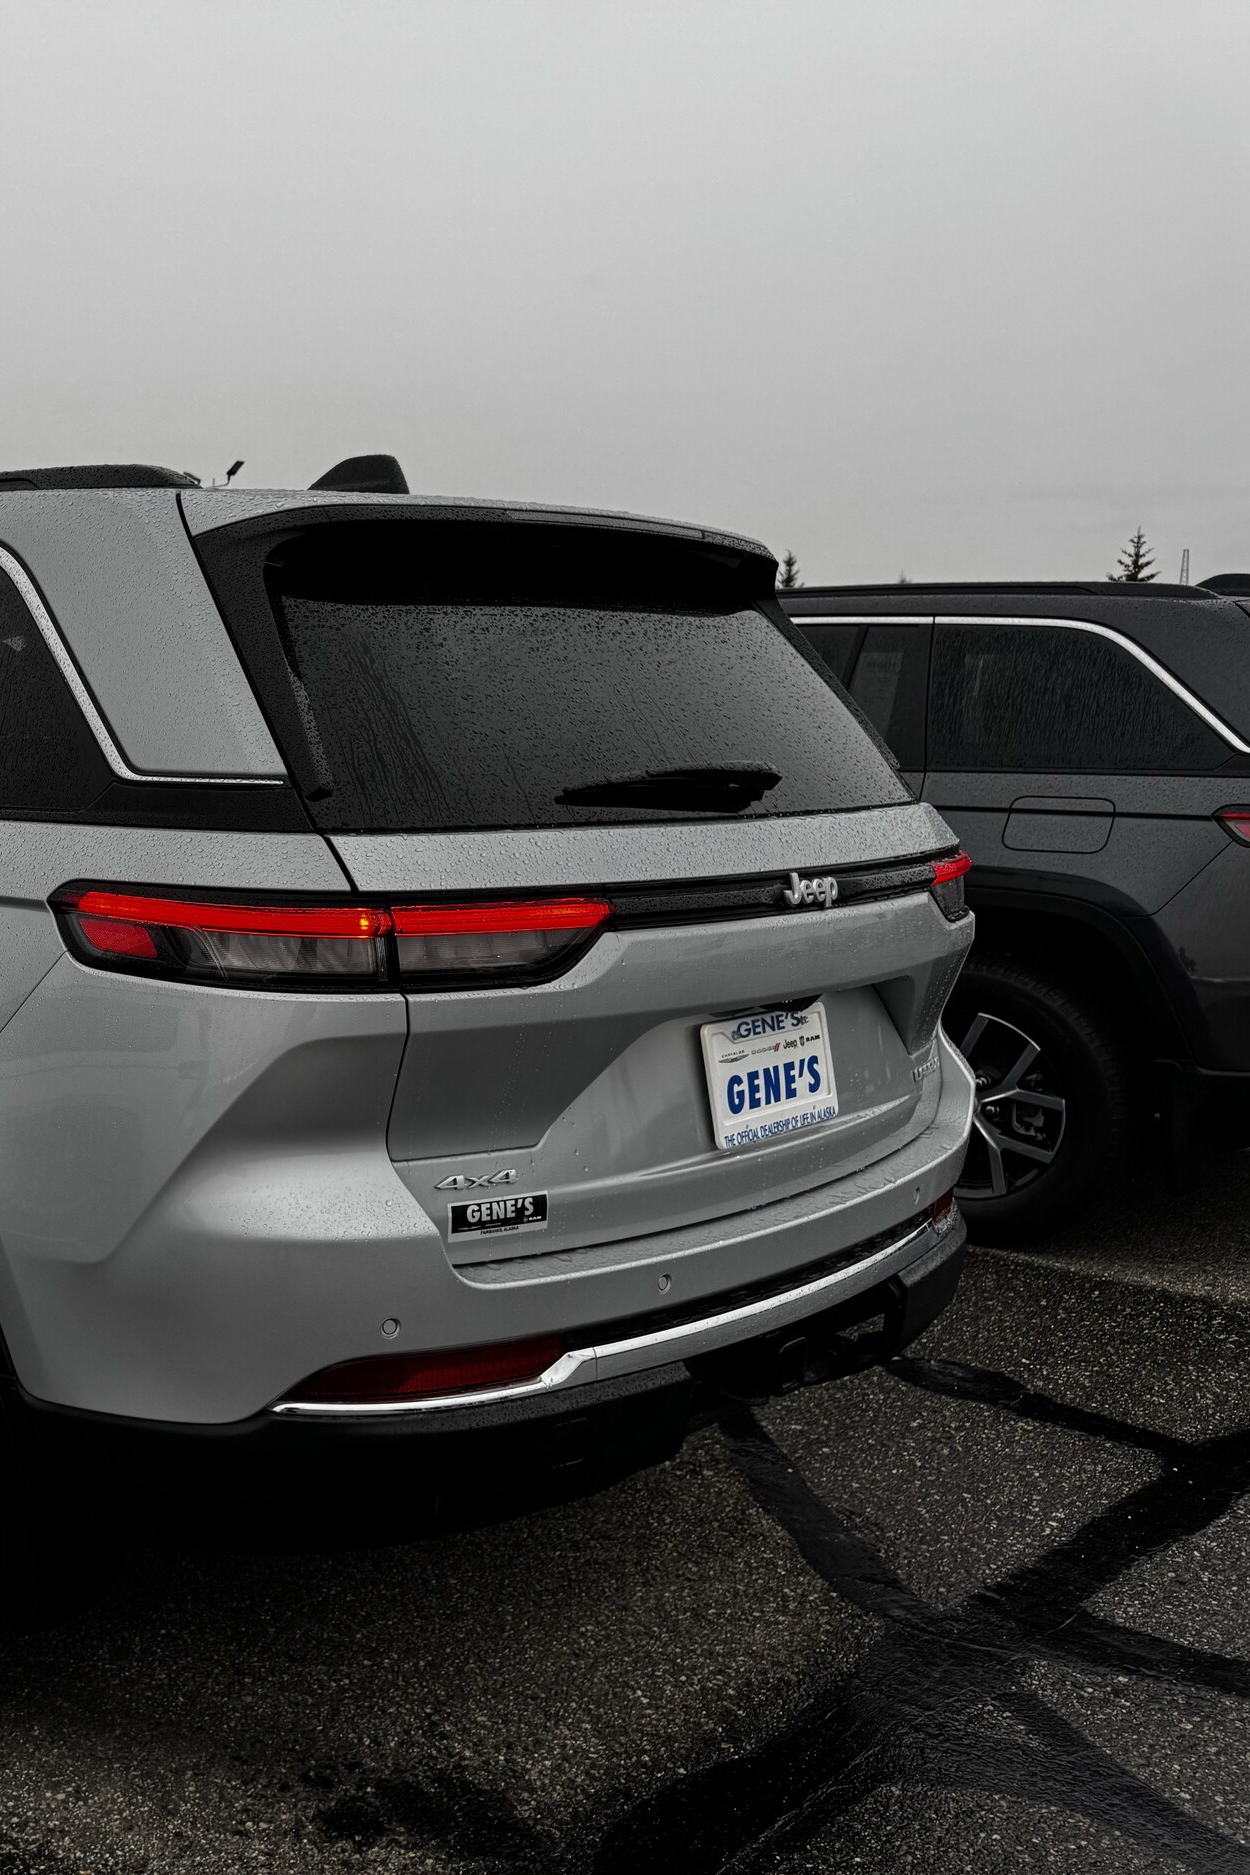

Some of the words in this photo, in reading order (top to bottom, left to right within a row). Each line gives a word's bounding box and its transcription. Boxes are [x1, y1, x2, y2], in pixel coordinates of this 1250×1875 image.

[783, 872, 838, 908] Jeep
[737, 1010, 800, 1039] GENE'S
[783, 1039, 799, 1051] Jeep
[806, 1034, 821, 1043] RAM
[727, 1055, 821, 1115] GENE'S
[724, 1135, 737, 1148] THE
[737, 1128, 760, 1144] OFFICIAL
[760, 1118, 791, 1137] DEALERSHIP
[791, 1115, 799, 1128] OF
[799, 1112, 809, 1126] LIFE
[809, 1110, 817, 1122] IN
[817, 1106, 836, 1120] ALASKA
[434, 1169, 518, 1190] 4x4
[467, 1197, 534, 1223] GENE'S
